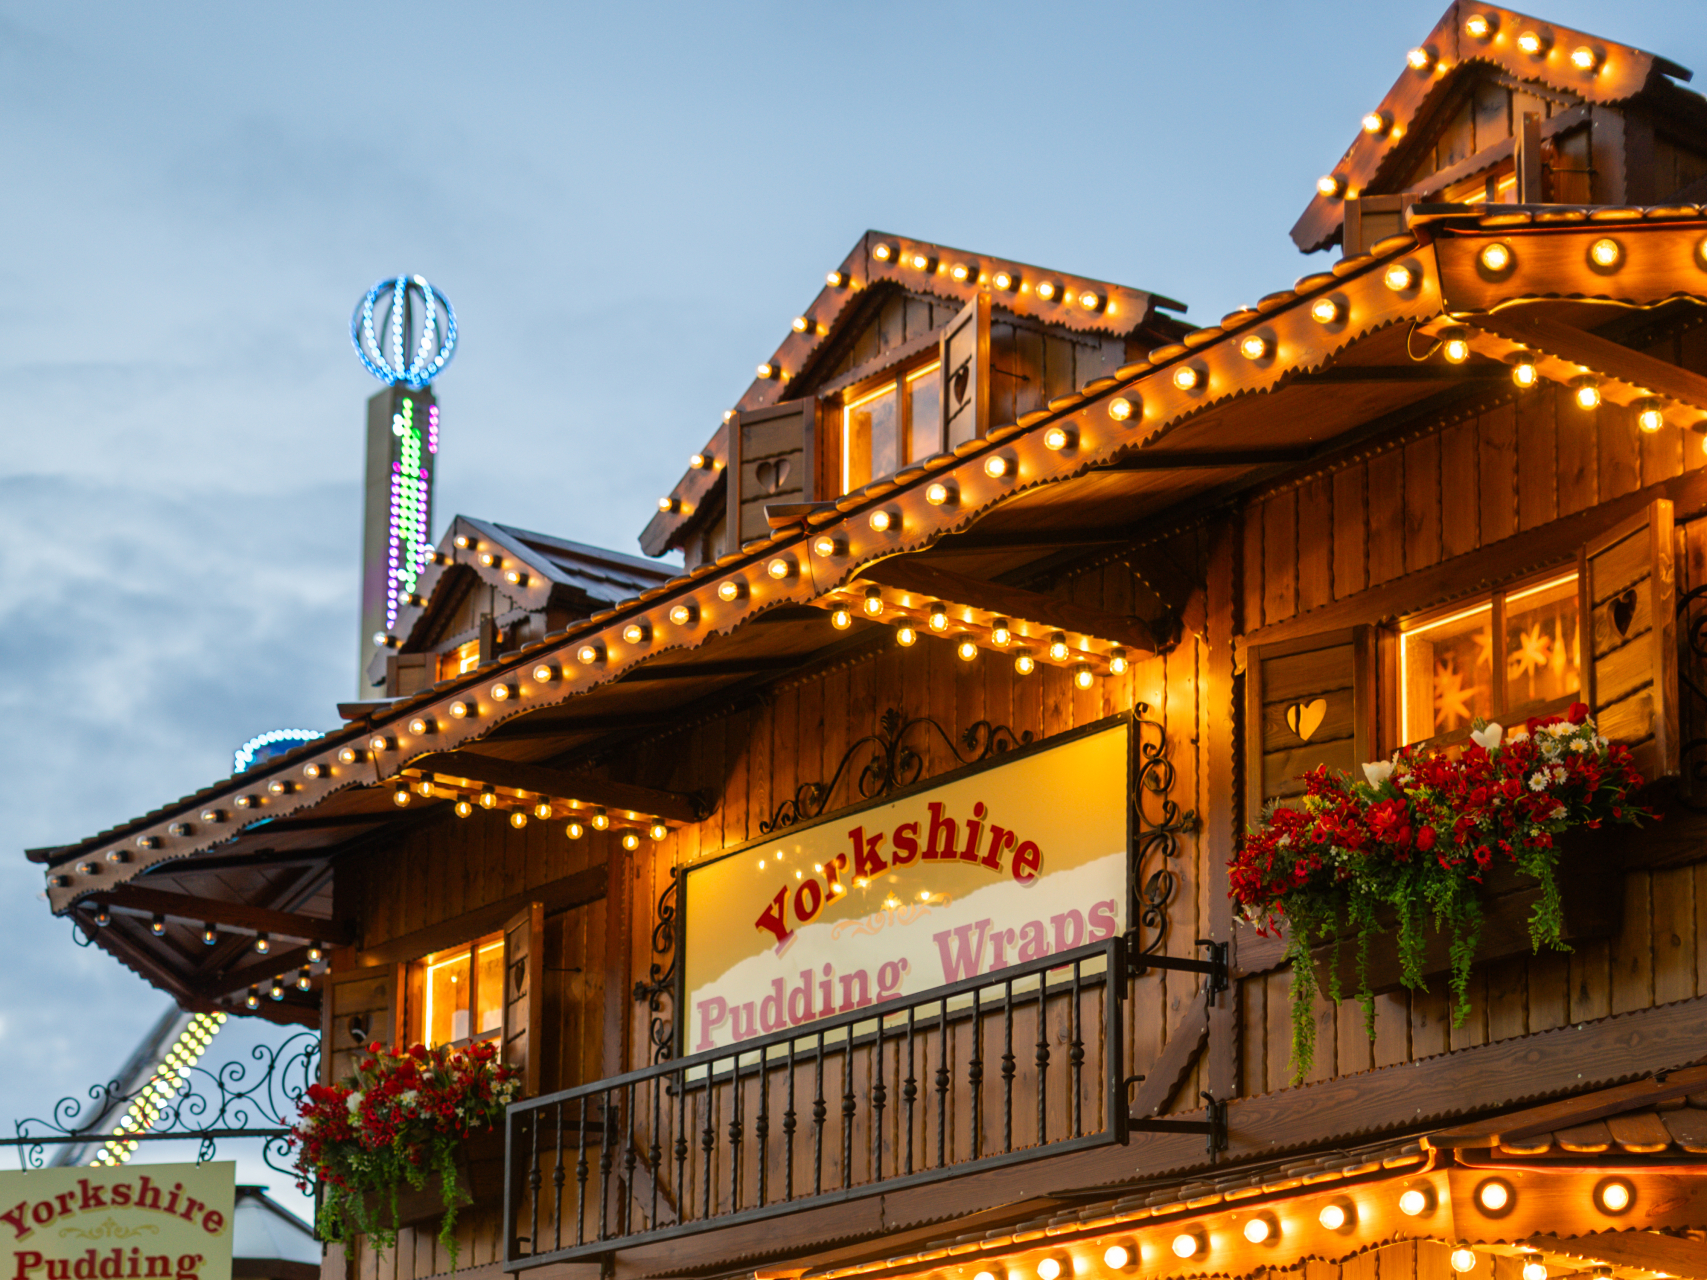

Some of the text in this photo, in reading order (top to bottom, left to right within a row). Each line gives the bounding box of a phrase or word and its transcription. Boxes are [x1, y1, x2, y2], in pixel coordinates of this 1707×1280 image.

[755, 802, 1042, 956] Yorkshire
[696, 899, 1117, 1052] Pudding Wraps
[0, 1175, 225, 1240] Yorkshire
